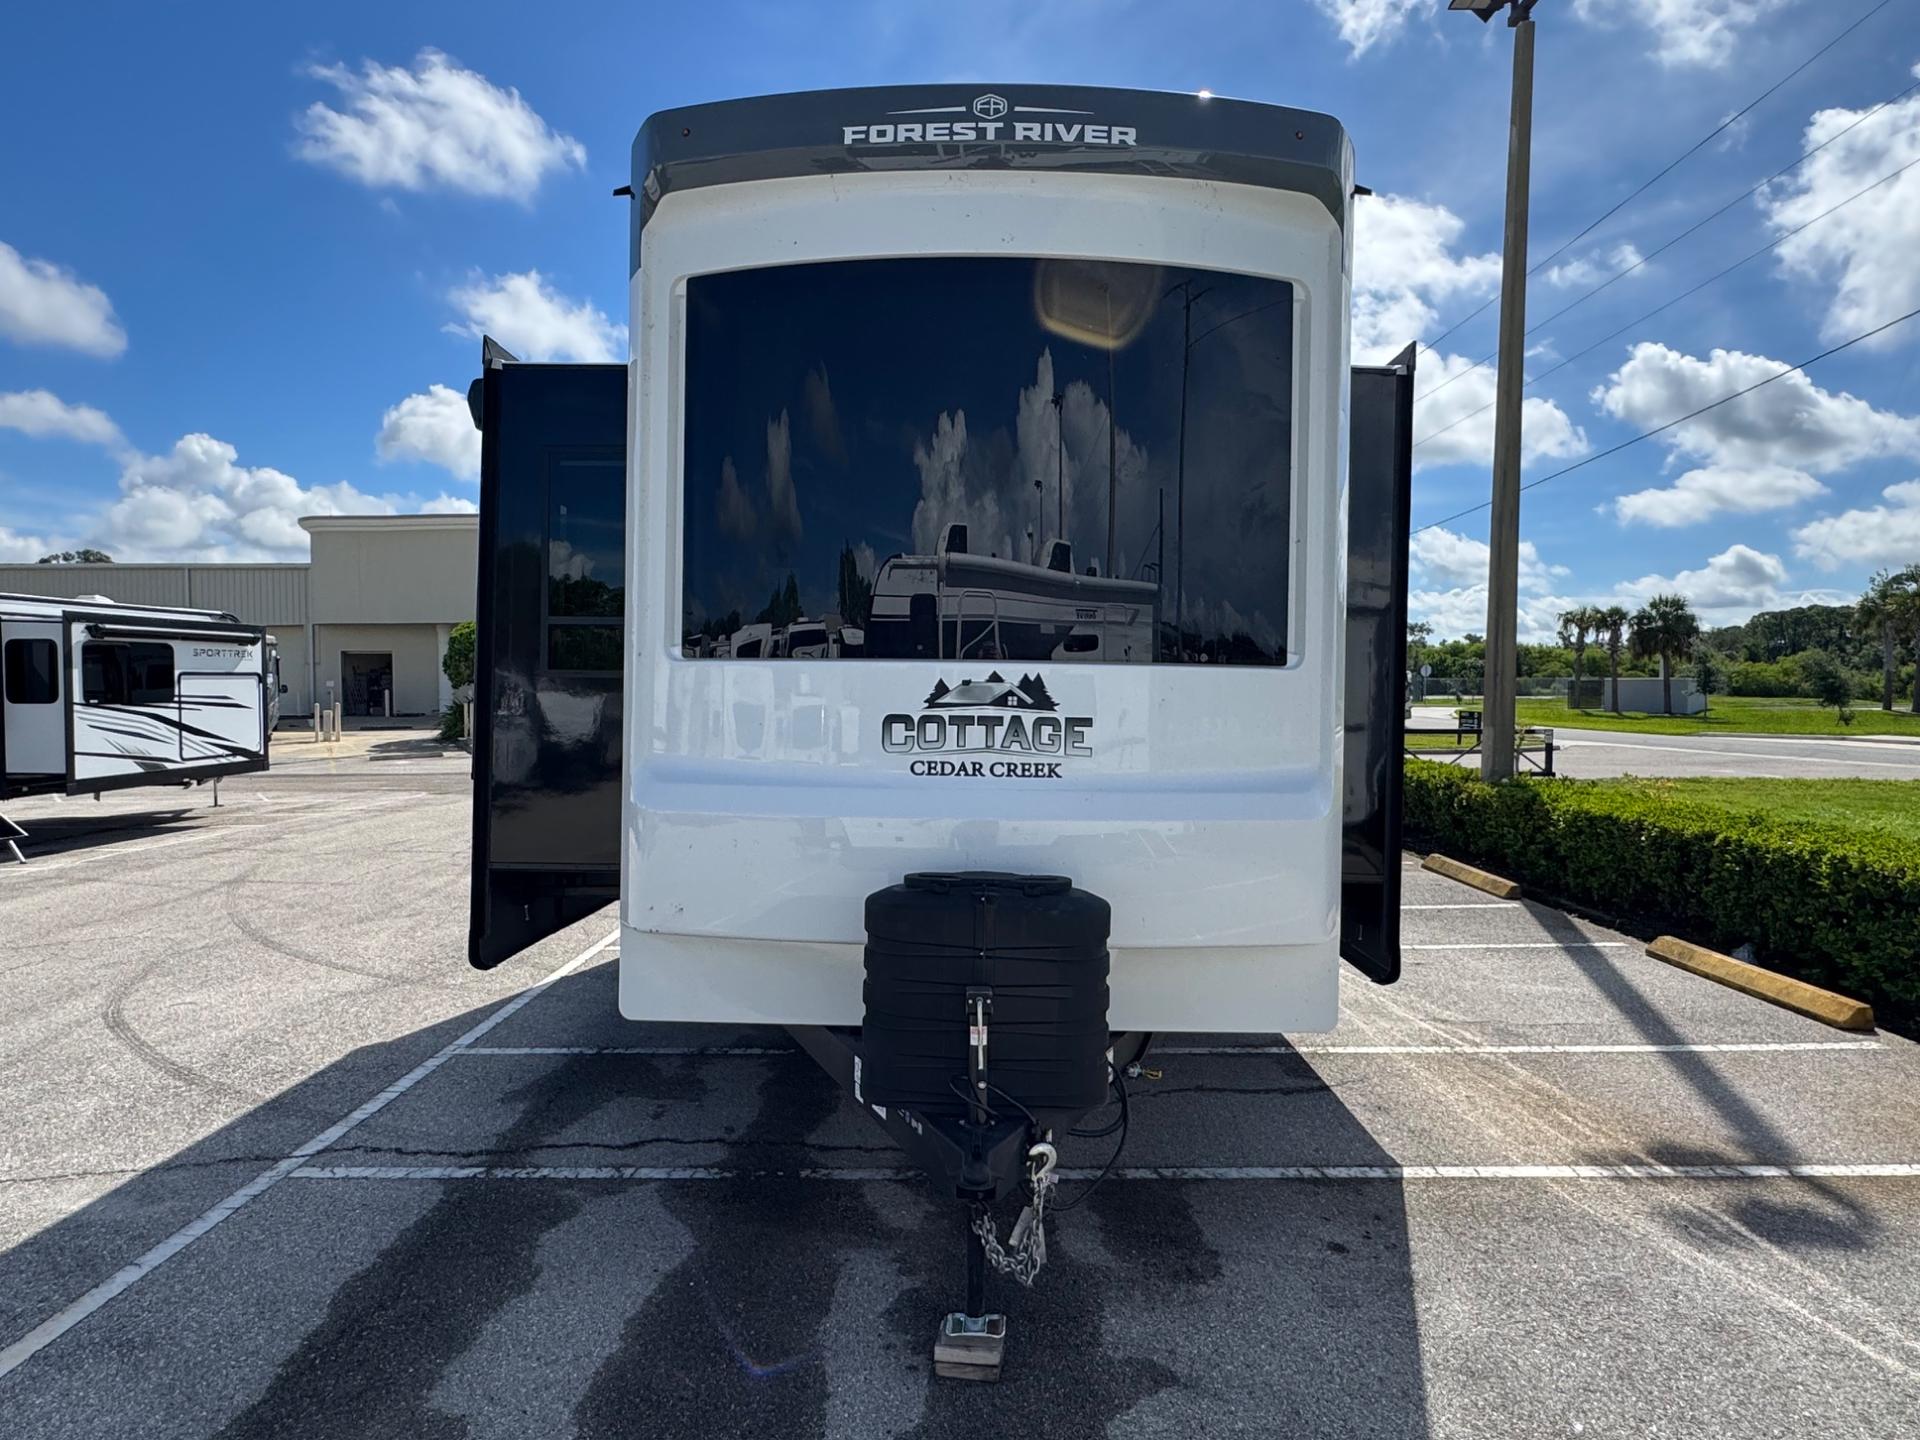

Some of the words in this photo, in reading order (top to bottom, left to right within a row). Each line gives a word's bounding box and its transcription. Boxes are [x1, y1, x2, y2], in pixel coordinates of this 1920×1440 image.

[843, 122, 1004, 144] FOREST
[1013, 122, 1137, 146] RIVER
[192, 648, 254, 659] SPORTTREK
[882, 713, 1093, 757] COTTAGE
[910, 760, 986, 778] CEDAR
[989, 761, 1062, 779] CREEK
